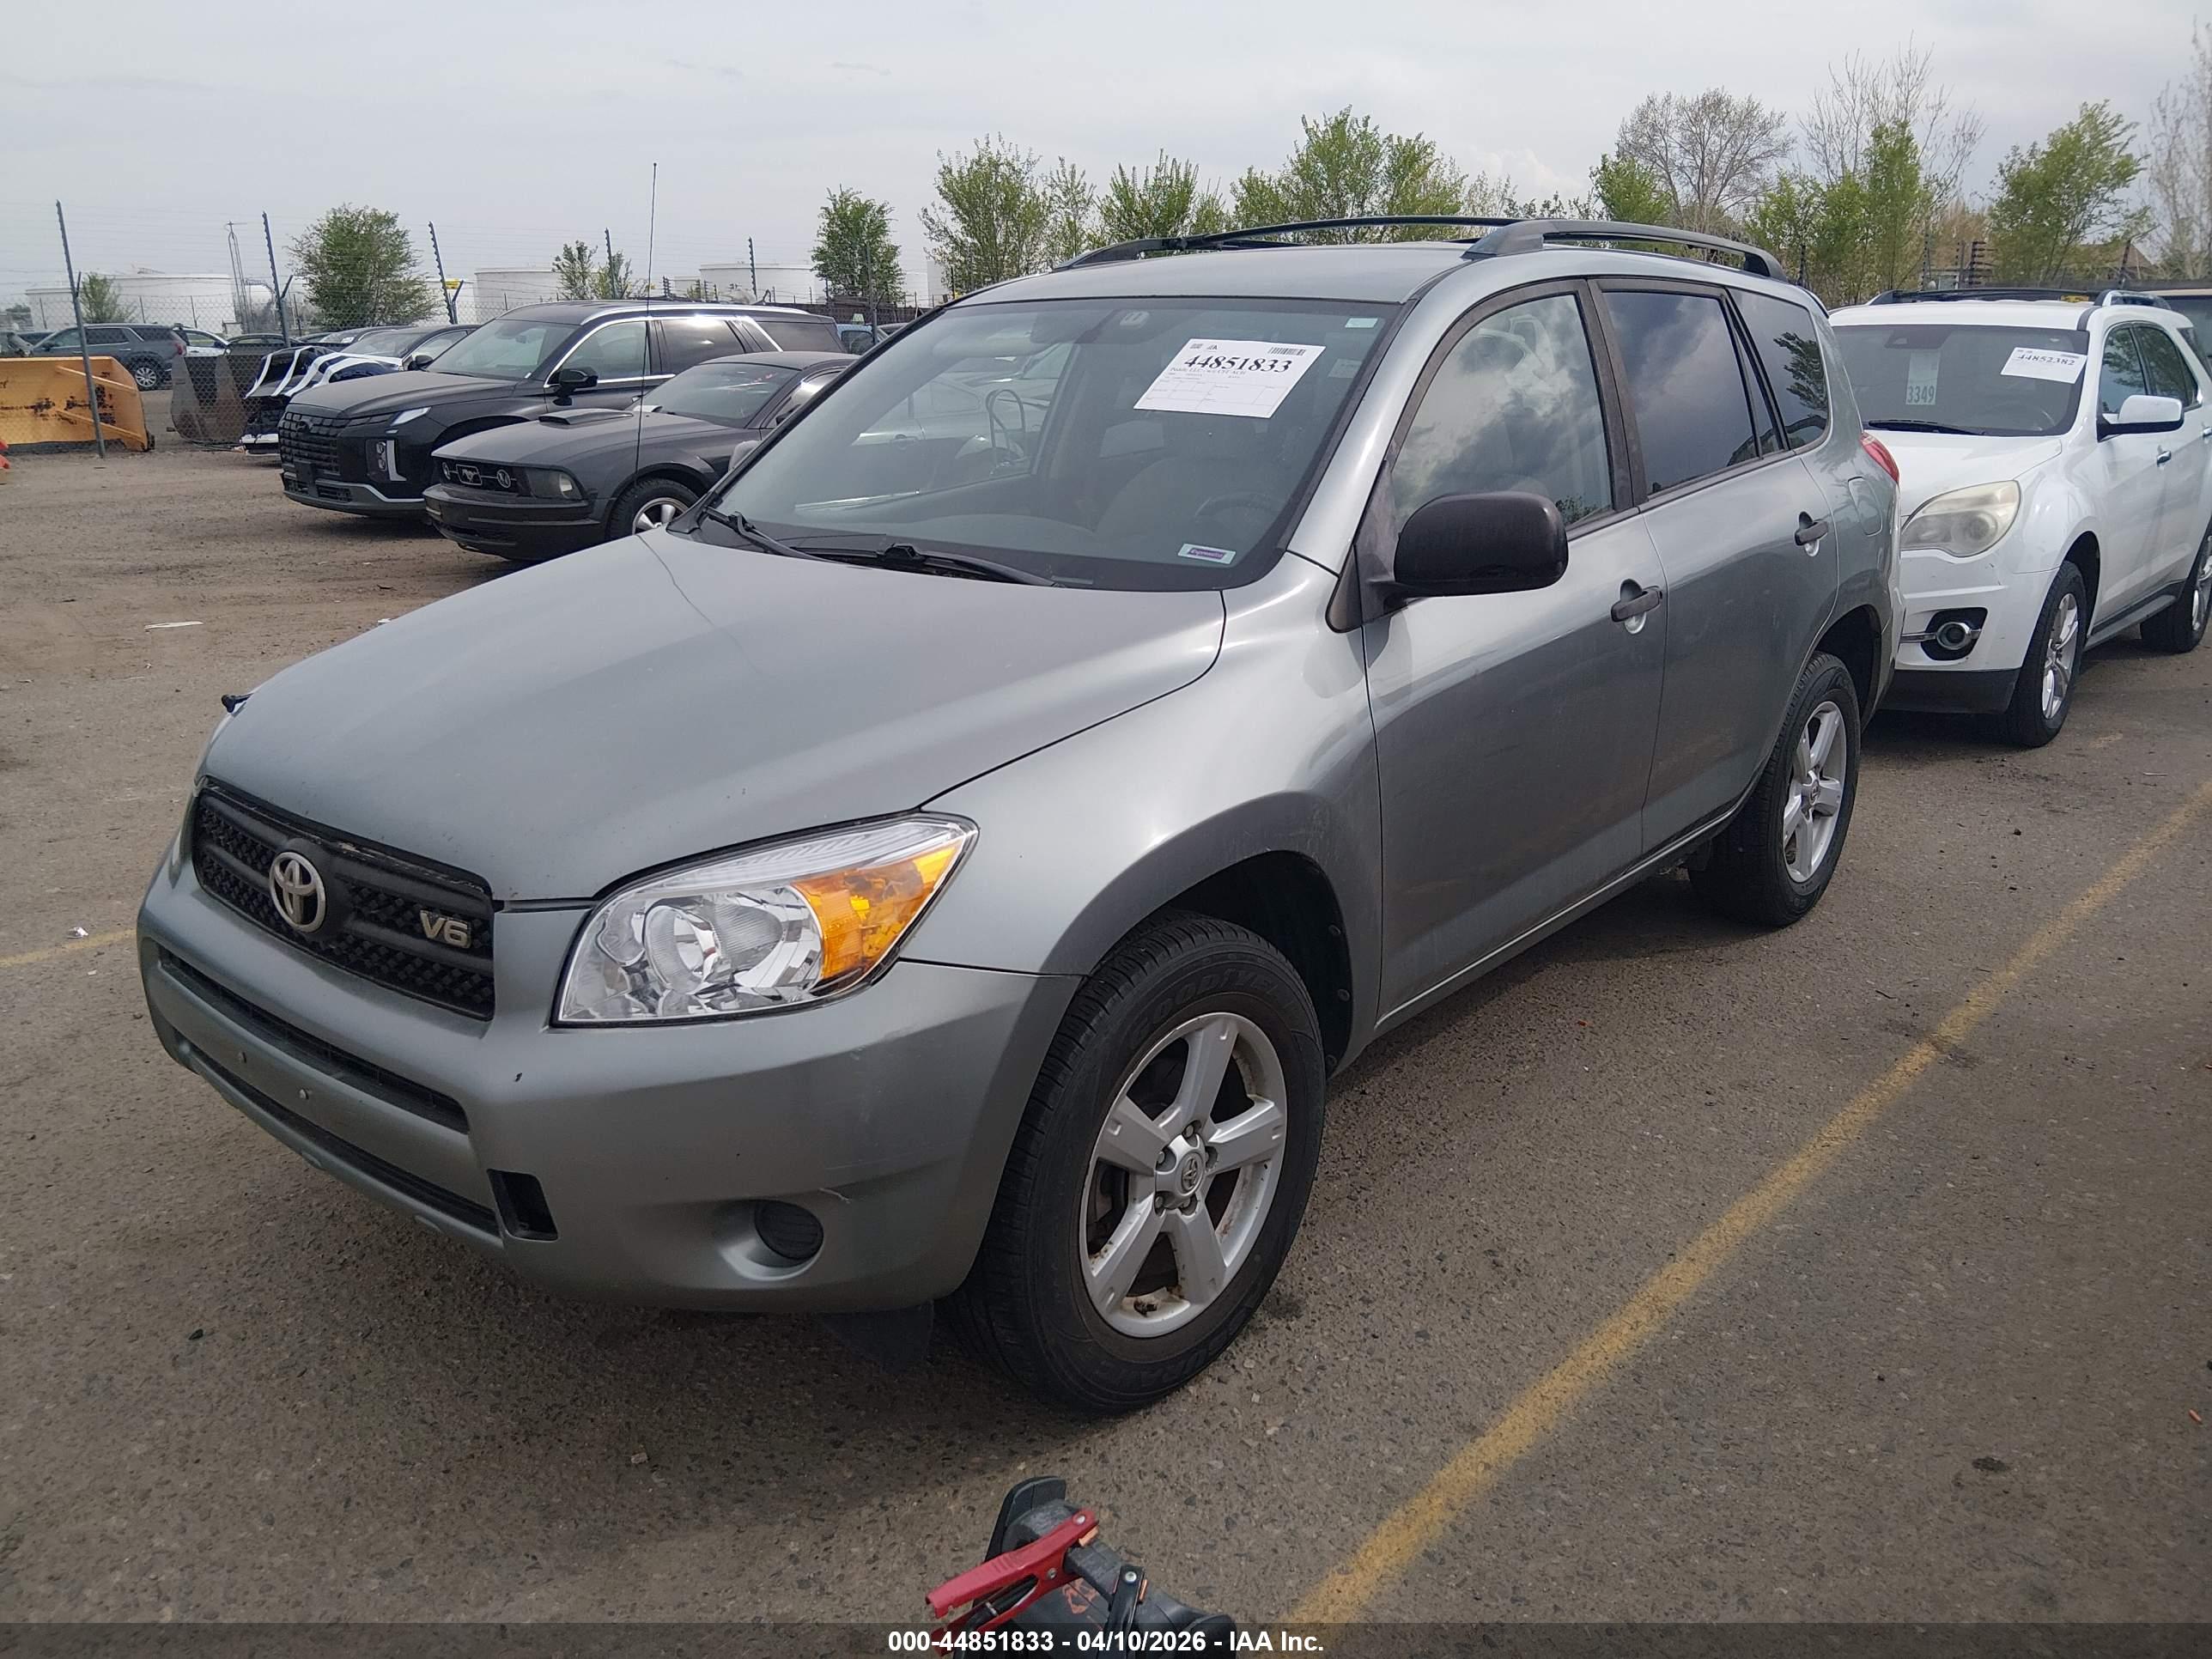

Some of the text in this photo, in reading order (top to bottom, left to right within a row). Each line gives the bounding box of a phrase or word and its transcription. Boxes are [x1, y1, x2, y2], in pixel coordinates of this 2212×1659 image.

[1183, 355, 1293, 374] 44851833
[2017, 353, 2076, 367] 44852382
[1906, 385, 1936, 404] 3349
[420, 909, 471, 948] V6
